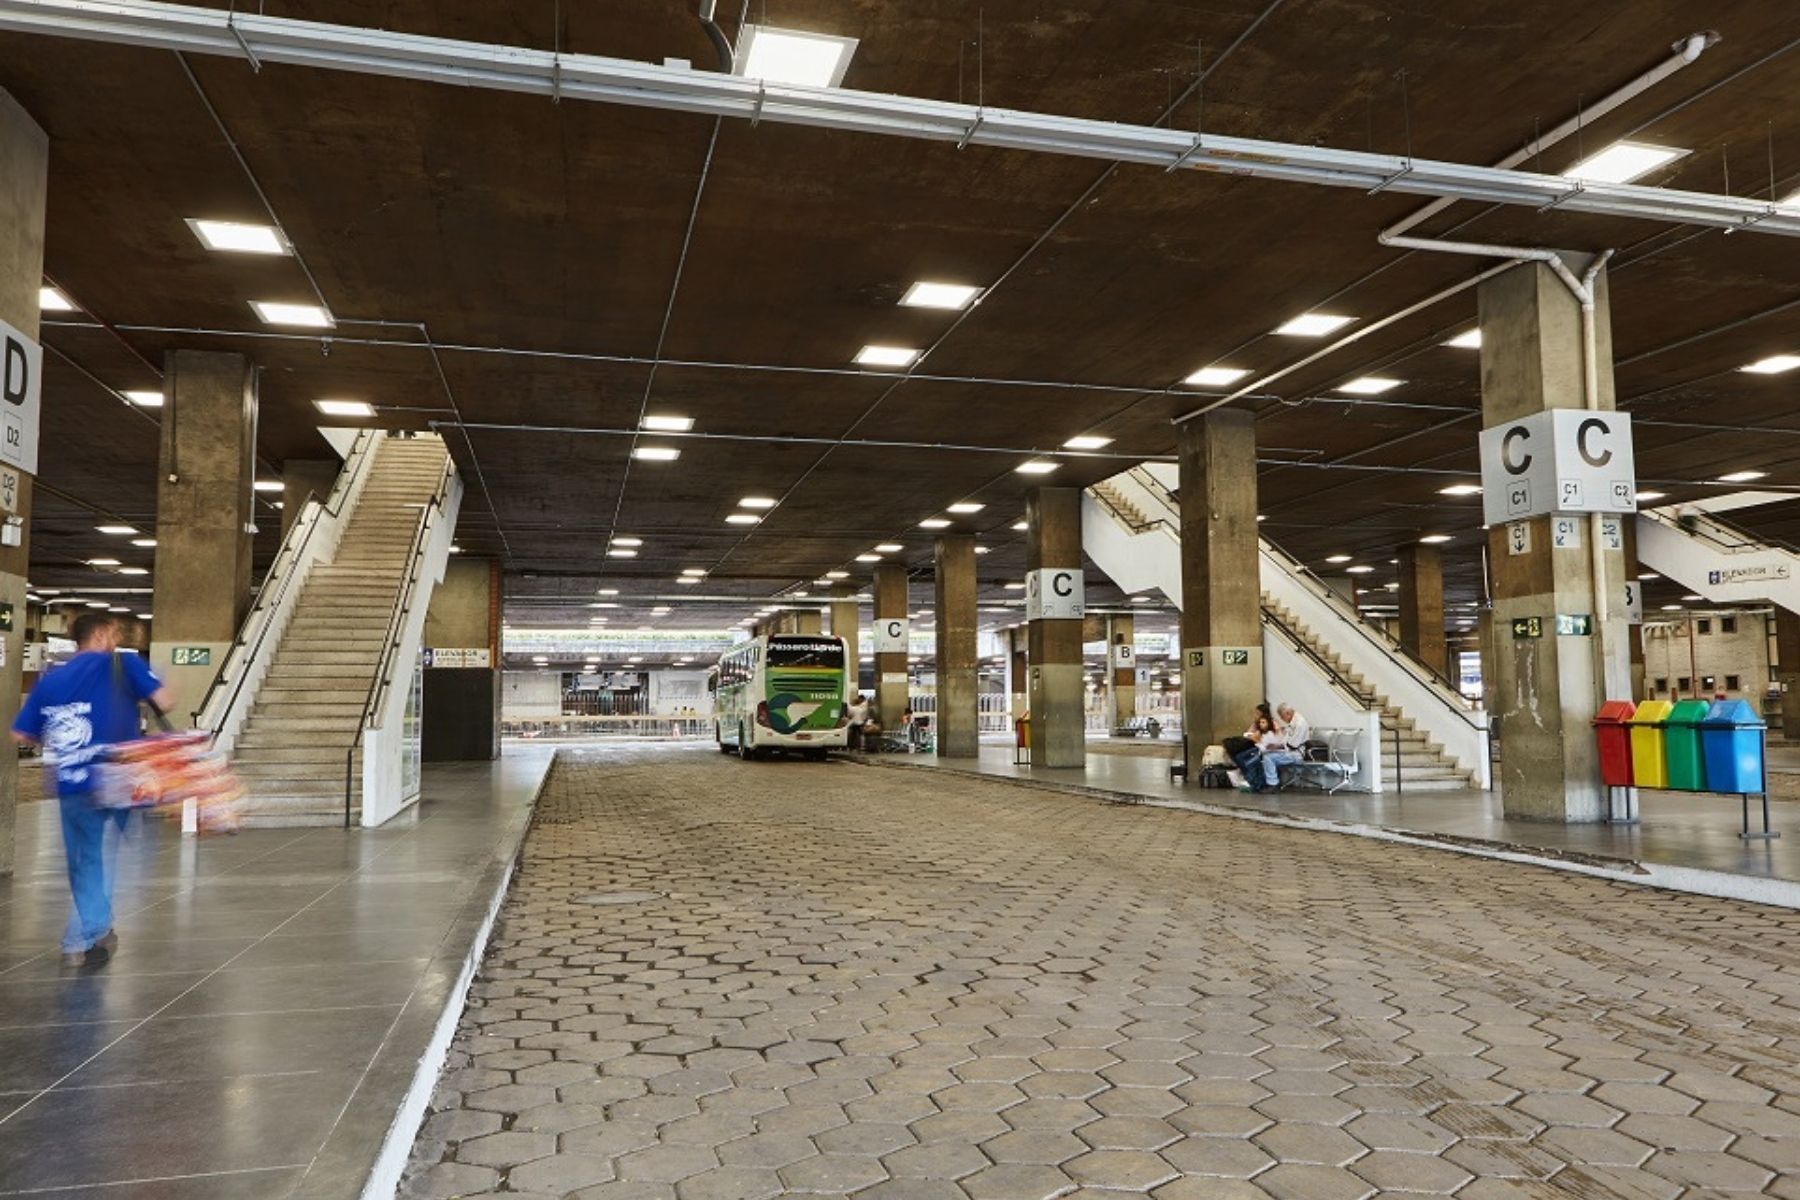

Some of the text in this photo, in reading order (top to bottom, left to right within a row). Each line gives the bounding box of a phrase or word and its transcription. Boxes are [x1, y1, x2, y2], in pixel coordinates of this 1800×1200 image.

[3, 335, 28, 407] D
[7, 425, 20, 447] D2
[1576, 417, 1613, 468] C
[1501, 425, 1533, 475] C
[1511, 489, 1527, 505] C1
[1564, 483, 1578, 495] C1
[1614, 485, 1630, 497] C2
[1513, 527, 1525, 539] C1
[1558, 522, 1574, 534] C1
[1052, 573, 1072, 597] C
[888, 621, 902, 638] C
[1121, 646, 1130, 658] B
[1140, 670, 1146, 681] 1
